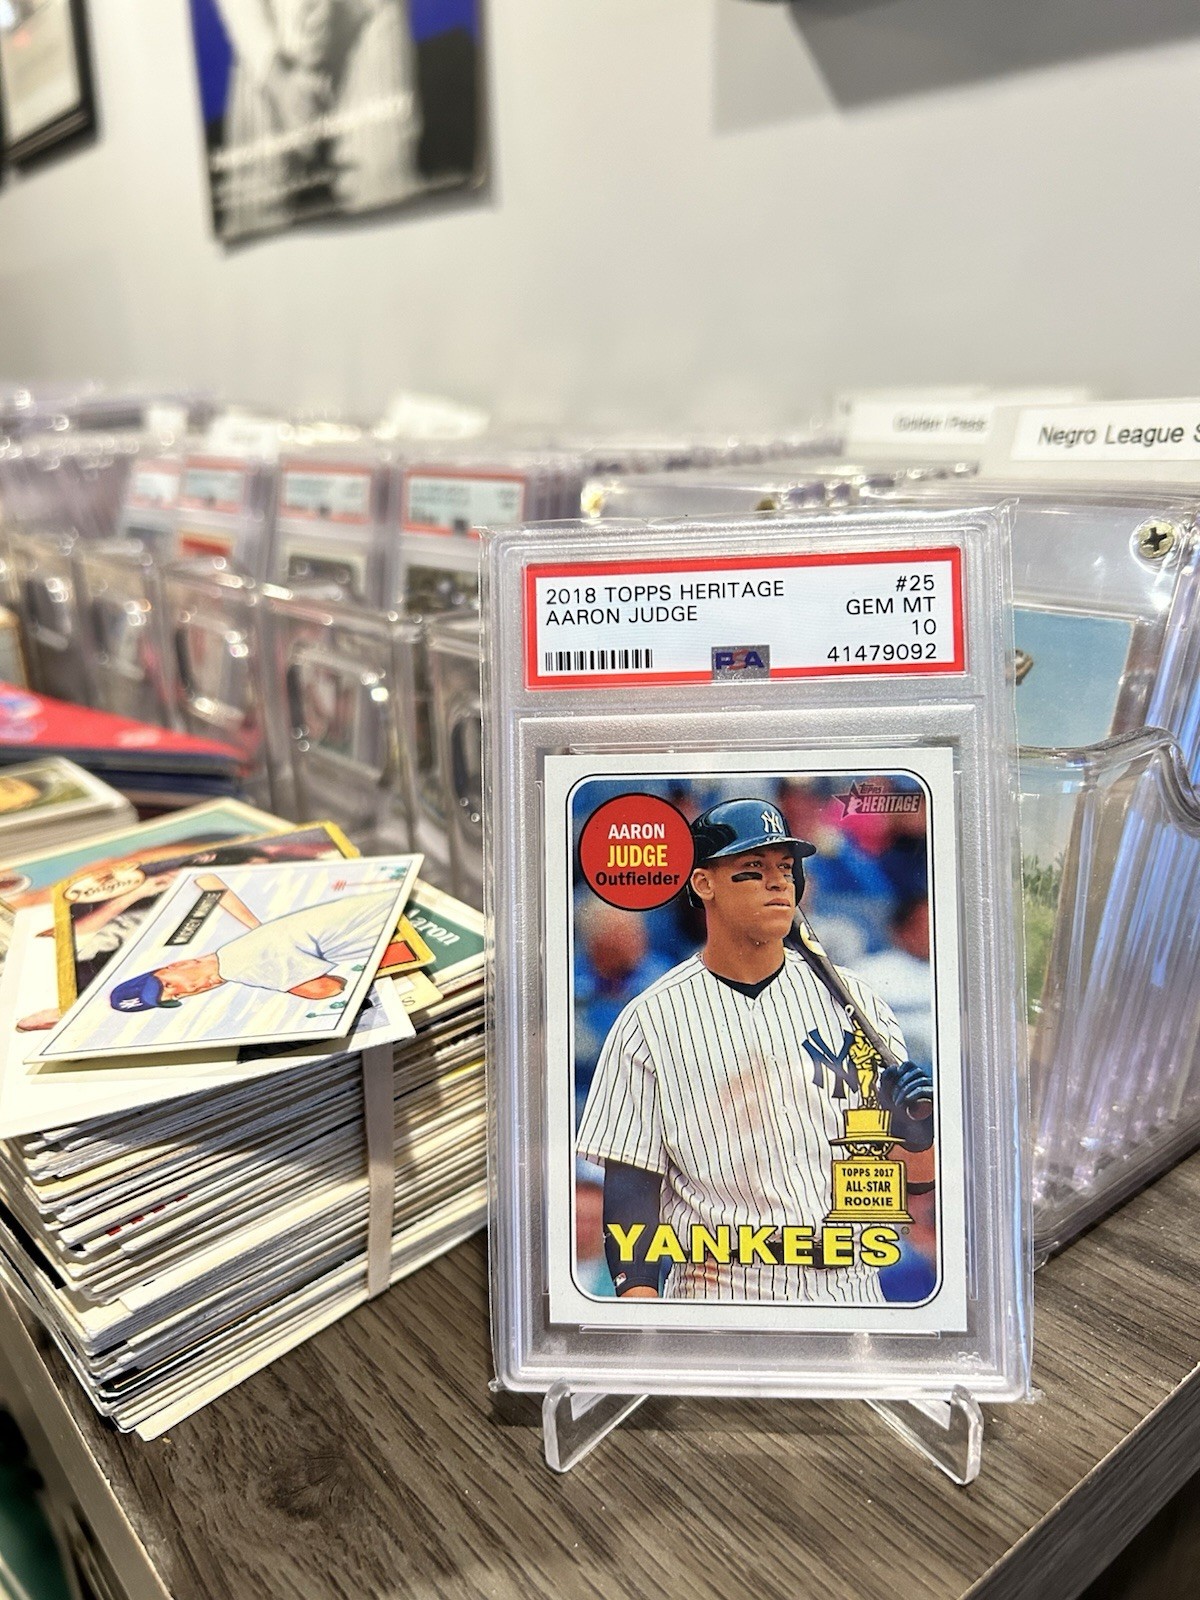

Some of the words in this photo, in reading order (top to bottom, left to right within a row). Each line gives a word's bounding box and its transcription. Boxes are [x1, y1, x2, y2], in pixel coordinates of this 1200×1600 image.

[1038, 426, 1096, 448] Negro
[1105, 424, 1184, 448] League
[896, 574, 935, 592] #25
[546, 587, 596, 605] 2018
[604, 585, 672, 603] TOPPS
[680, 580, 785, 600] HERITAGE
[846, 597, 894, 615] GEM
[903, 596, 936, 613] MT
[546, 608, 620, 626] AARON
[628, 605, 698, 624] JUDGE
[912, 618, 937, 636] 10
[715, 649, 764, 670] PSA
[827, 643, 937, 662] 41479092
[861, 795, 920, 813] HERITAGE
[608, 823, 665, 840] AARON
[607, 844, 668, 868] JUDGE
[595, 871, 680, 886] Outfielder
[842, 1167, 870, 1177] TOPPS
[874, 1168, 894, 1177] 2017
[846, 1180, 891, 1192] ALL-STAR
[844, 1196, 893, 1207] ROOKIE
[606, 1223, 902, 1267] YANKEES
